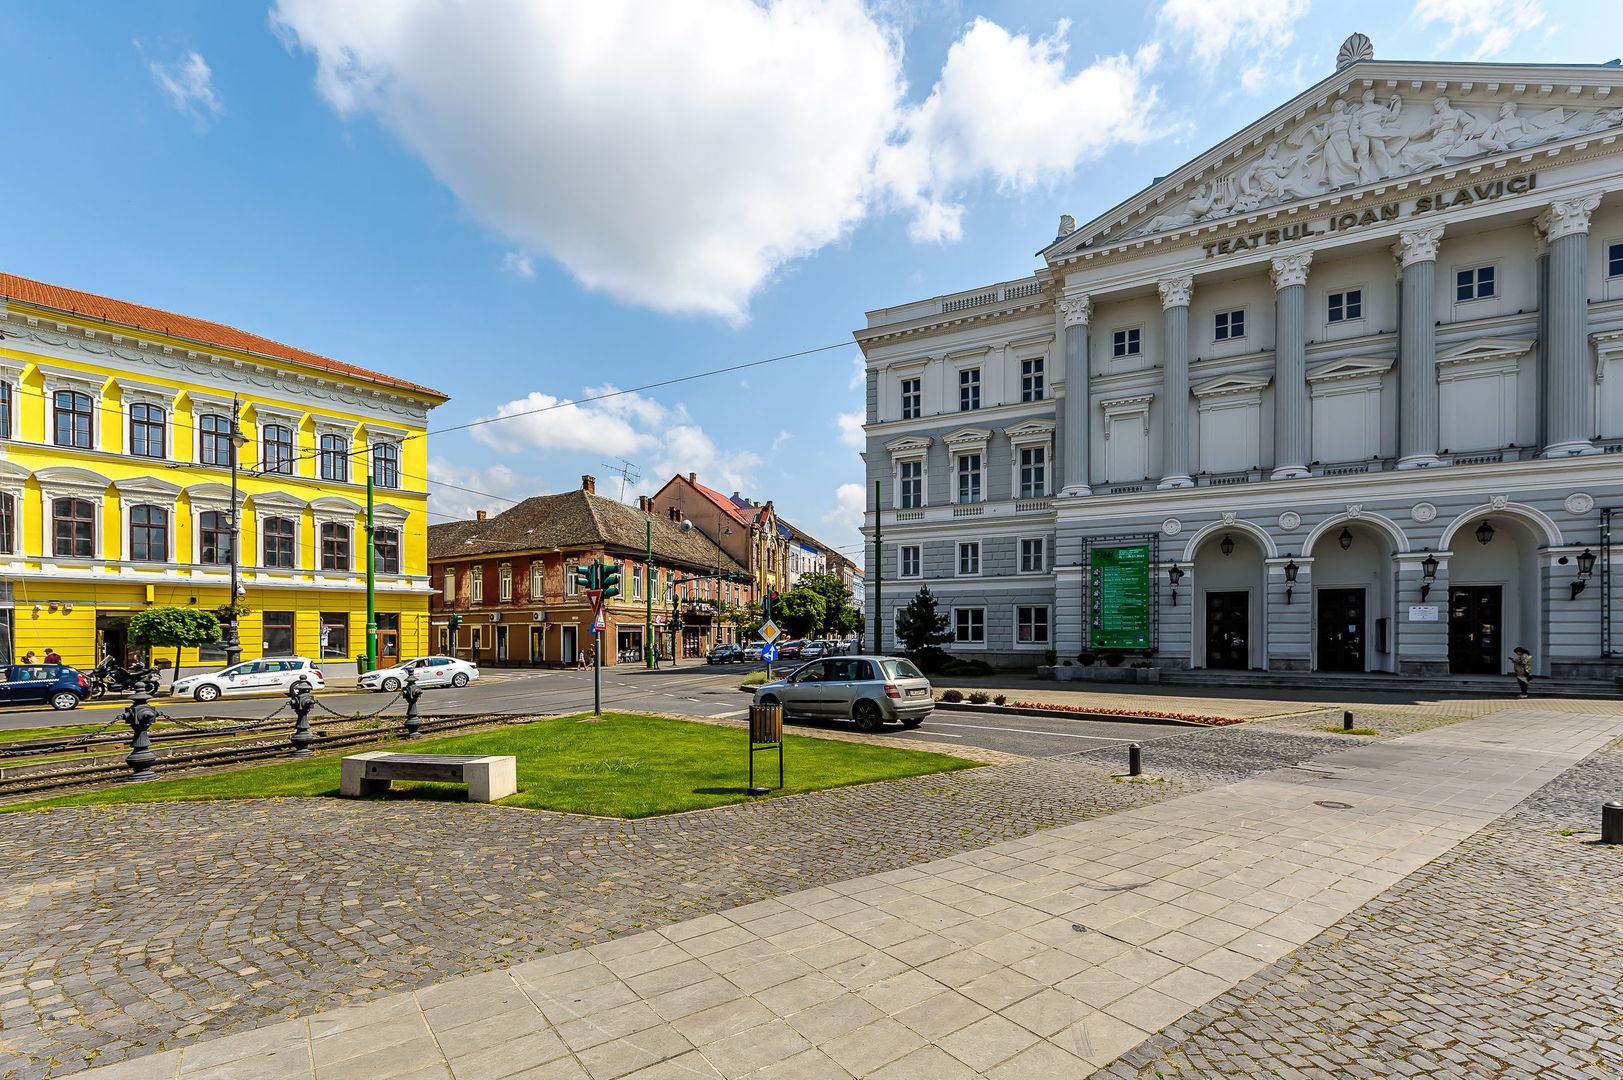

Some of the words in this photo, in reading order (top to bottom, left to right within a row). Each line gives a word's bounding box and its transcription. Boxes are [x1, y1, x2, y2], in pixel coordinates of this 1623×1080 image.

[1203, 223, 1314, 258] TEATRUL
[1330, 203, 1399, 232] IOAN
[1411, 174, 1537, 215] SLAVICI
